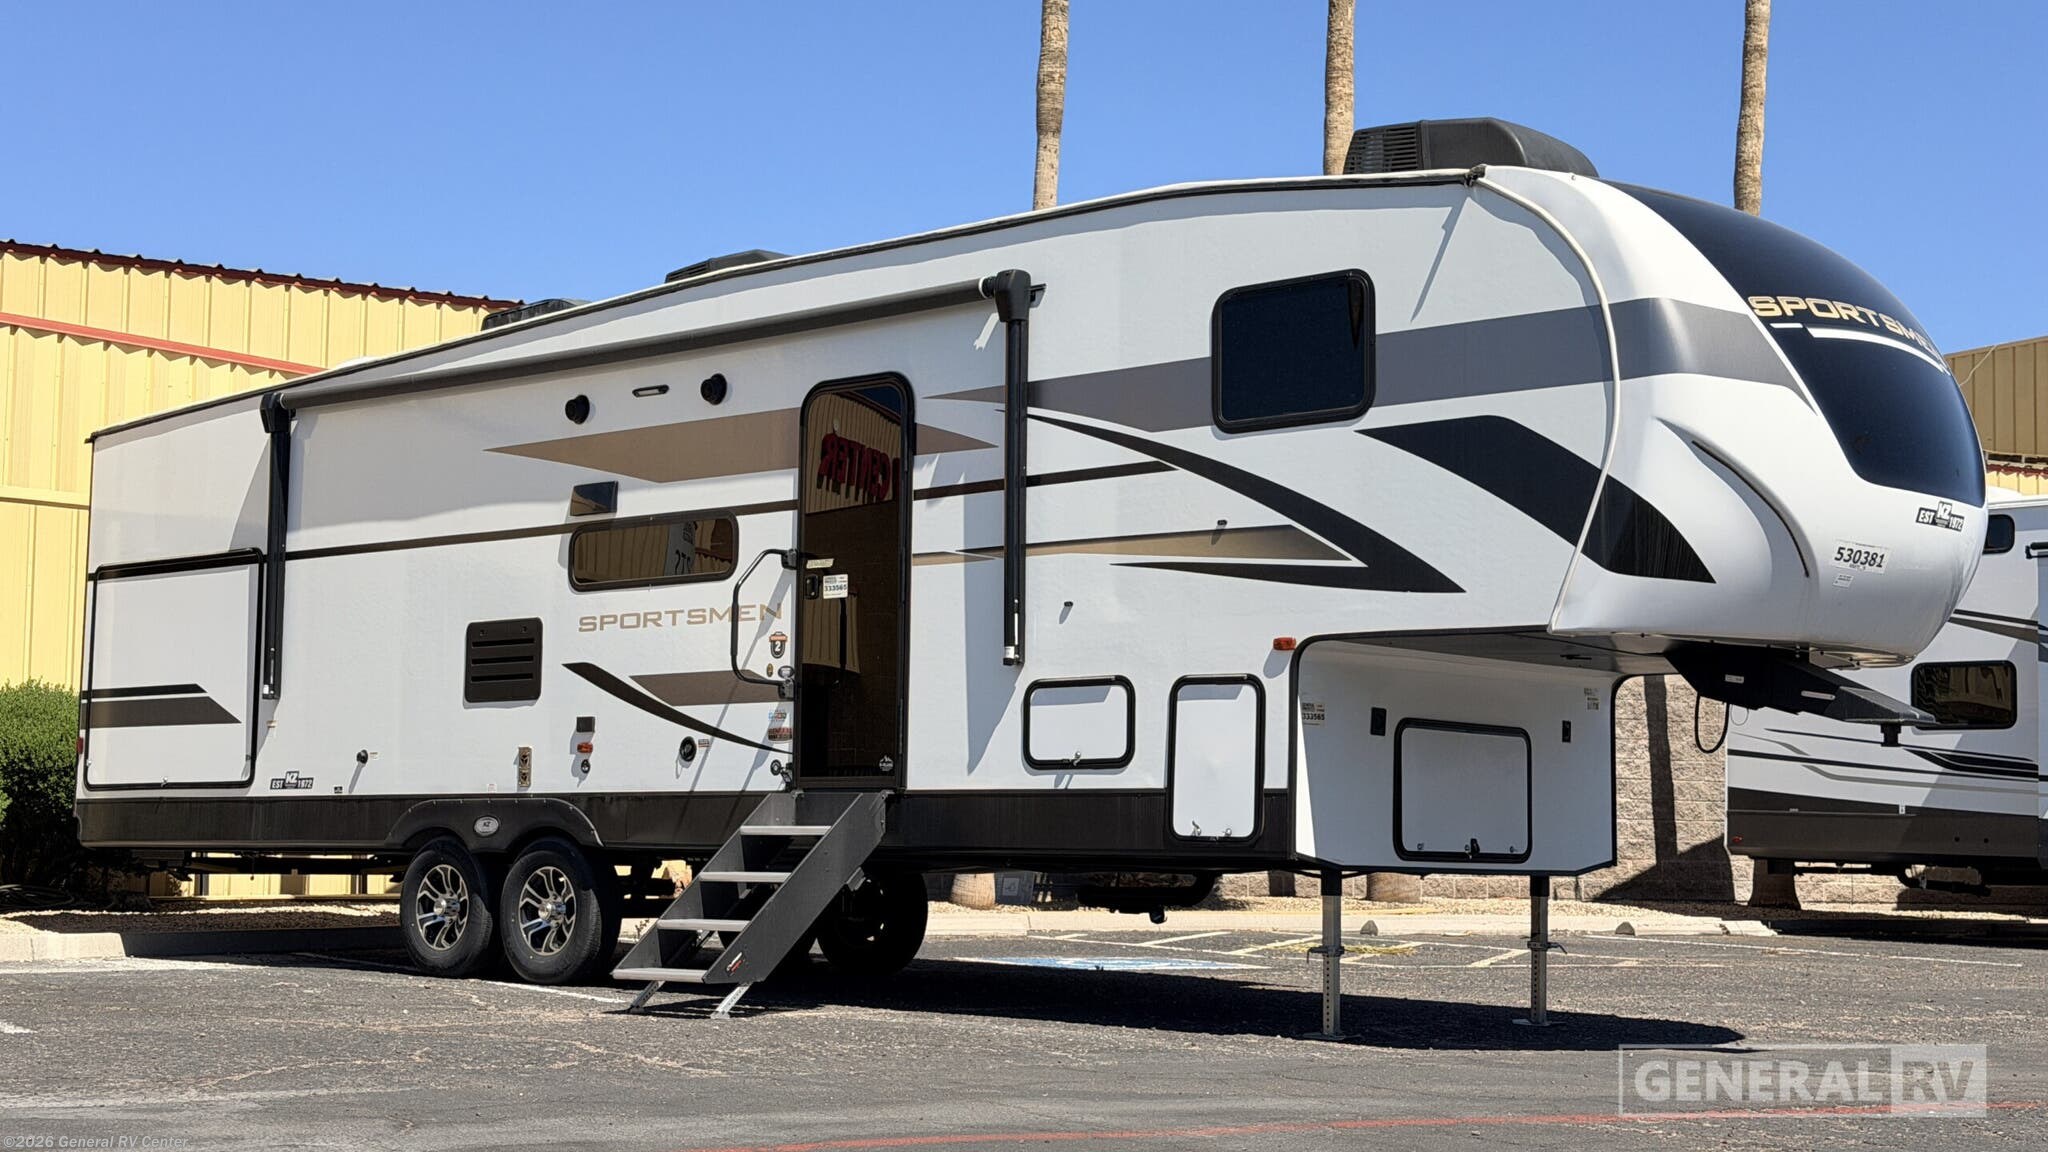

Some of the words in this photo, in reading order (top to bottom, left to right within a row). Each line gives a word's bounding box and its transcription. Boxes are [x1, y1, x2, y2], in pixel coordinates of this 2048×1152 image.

[1937, 502, 1951, 519] KZ
[1918, 510, 1935, 524] EST
[1949, 516, 1964, 530] 1972
[1834, 546, 1885, 568] 530381
[578, 603, 783, 632] SPORTSMEN
[774, 640, 782, 652] 2
[272, 780, 284, 789] EST
[286, 772, 298, 784] KZ
